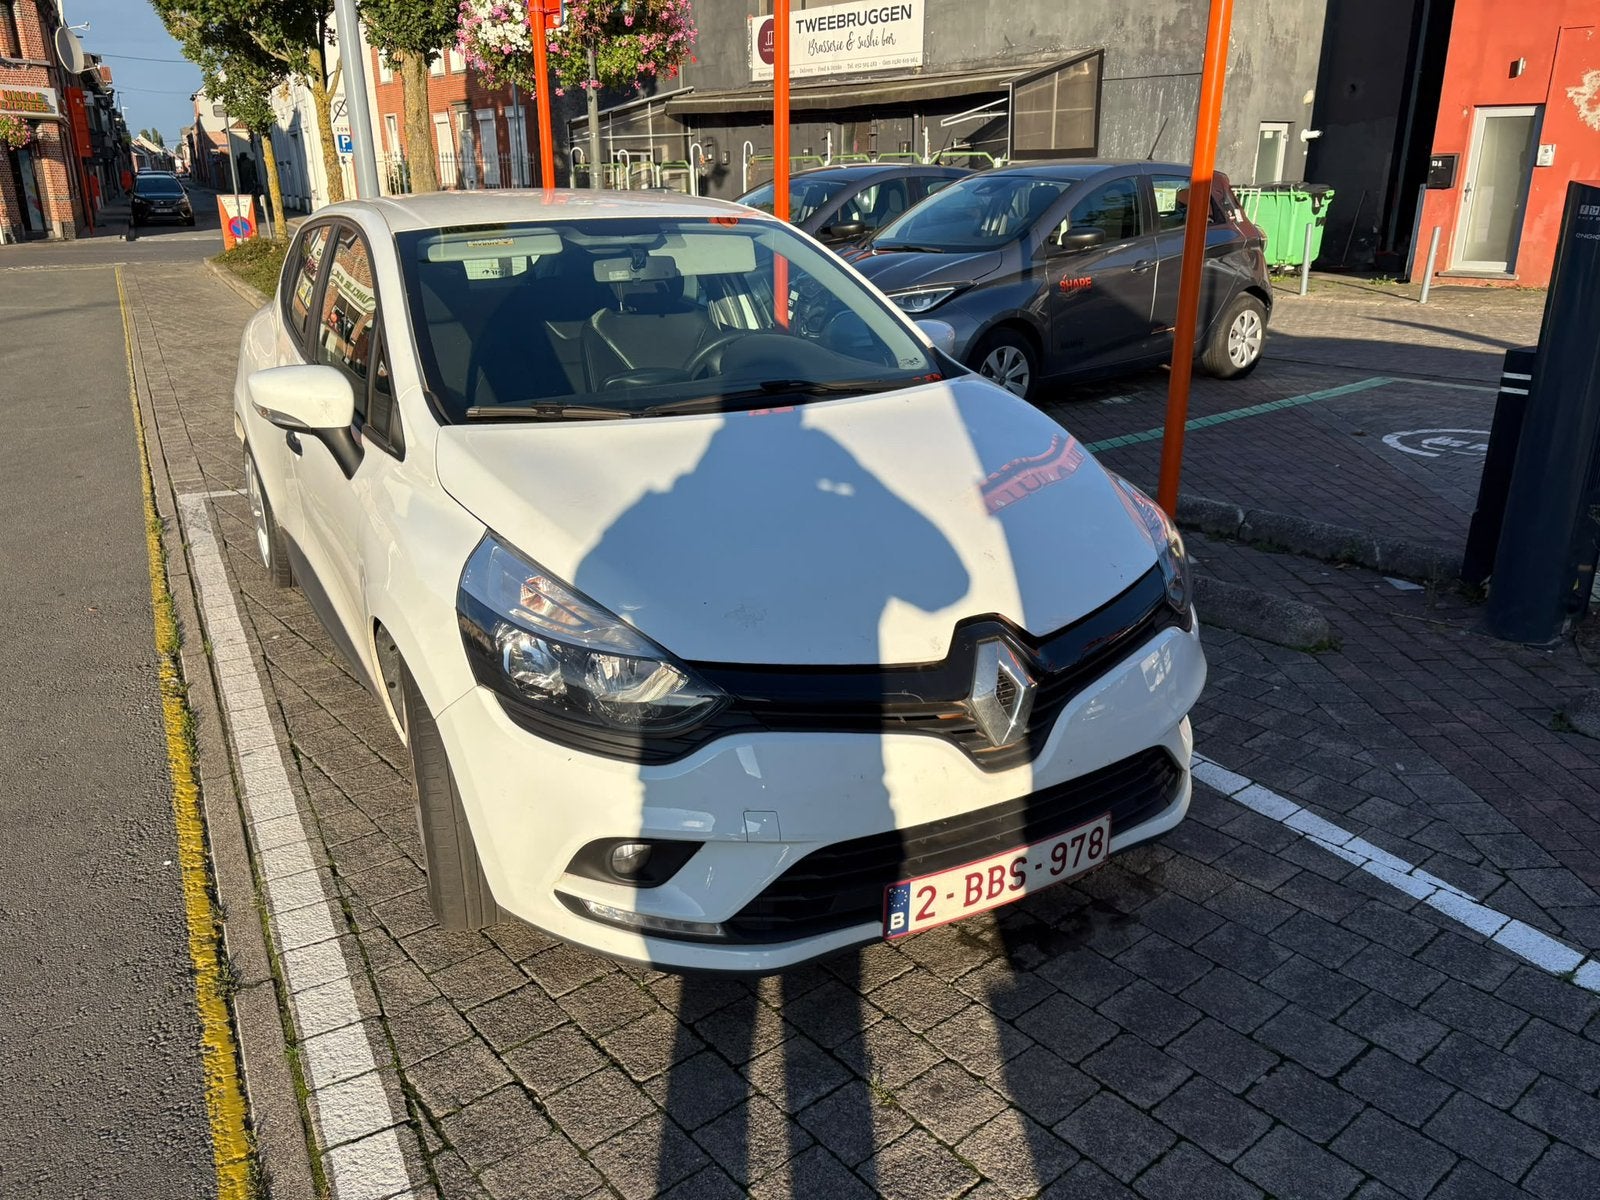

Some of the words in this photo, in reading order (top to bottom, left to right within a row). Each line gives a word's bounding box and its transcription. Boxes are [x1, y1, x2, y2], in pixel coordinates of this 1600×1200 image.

[796, 4, 912, 34] TWEEBRUGGEN
[808, 39, 844, 56] Brasserie
[846, 31, 855, 51] &
[857, 29, 879, 49] sushi
[881, 28, 896, 46] bar
[915, 826, 1104, 921] 2-BBS-978
[890, 912, 904, 930] B
